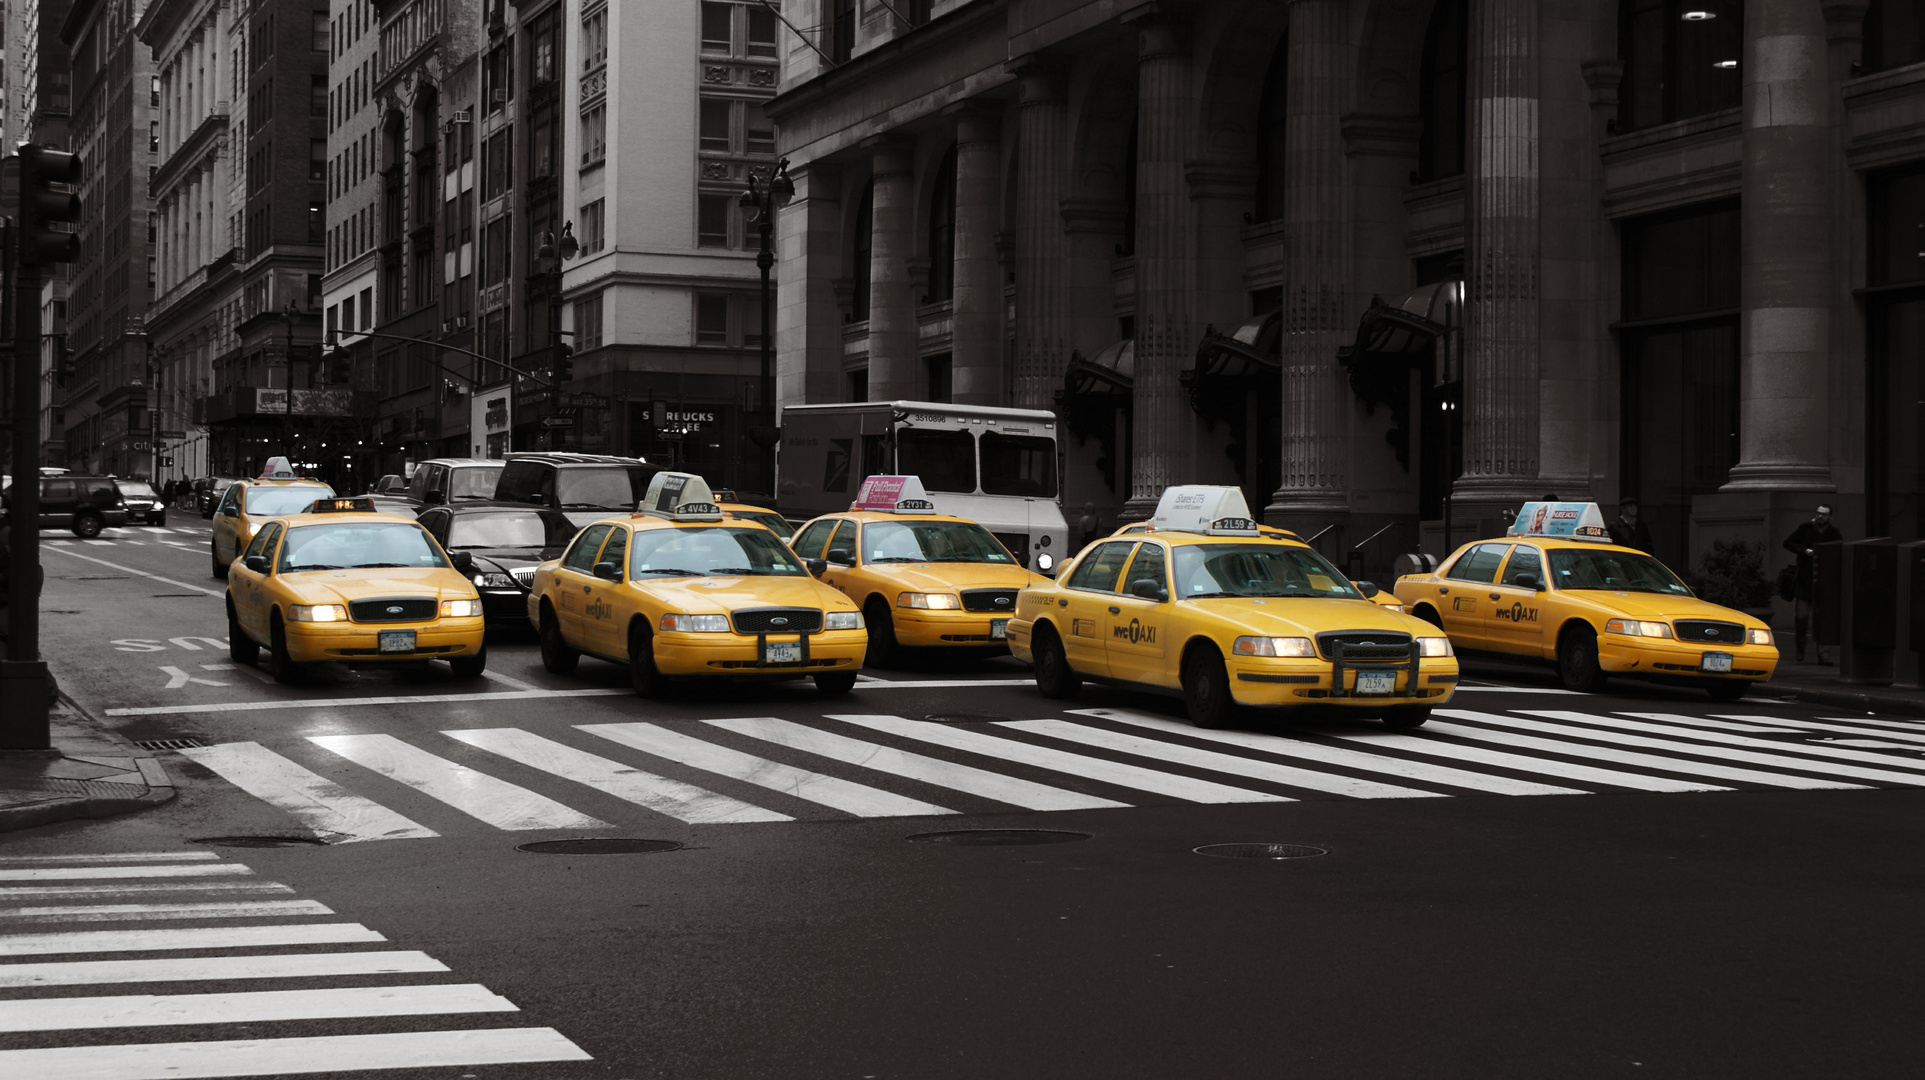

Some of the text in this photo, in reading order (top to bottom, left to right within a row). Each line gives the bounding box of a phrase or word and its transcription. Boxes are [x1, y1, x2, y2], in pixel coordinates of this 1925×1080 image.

[642, 411, 715, 422] SRBUCKS
[916, 414, 946, 424] 3510896
[687, 504, 708, 513] 4V43
[906, 501, 923, 509] 2Y31
[1223, 519, 1245, 529] 2L59
[1496, 602, 1538, 622] NYC TAXI
[1114, 626, 1128, 639] NYC
[1129, 618, 1156, 643] TAXI
